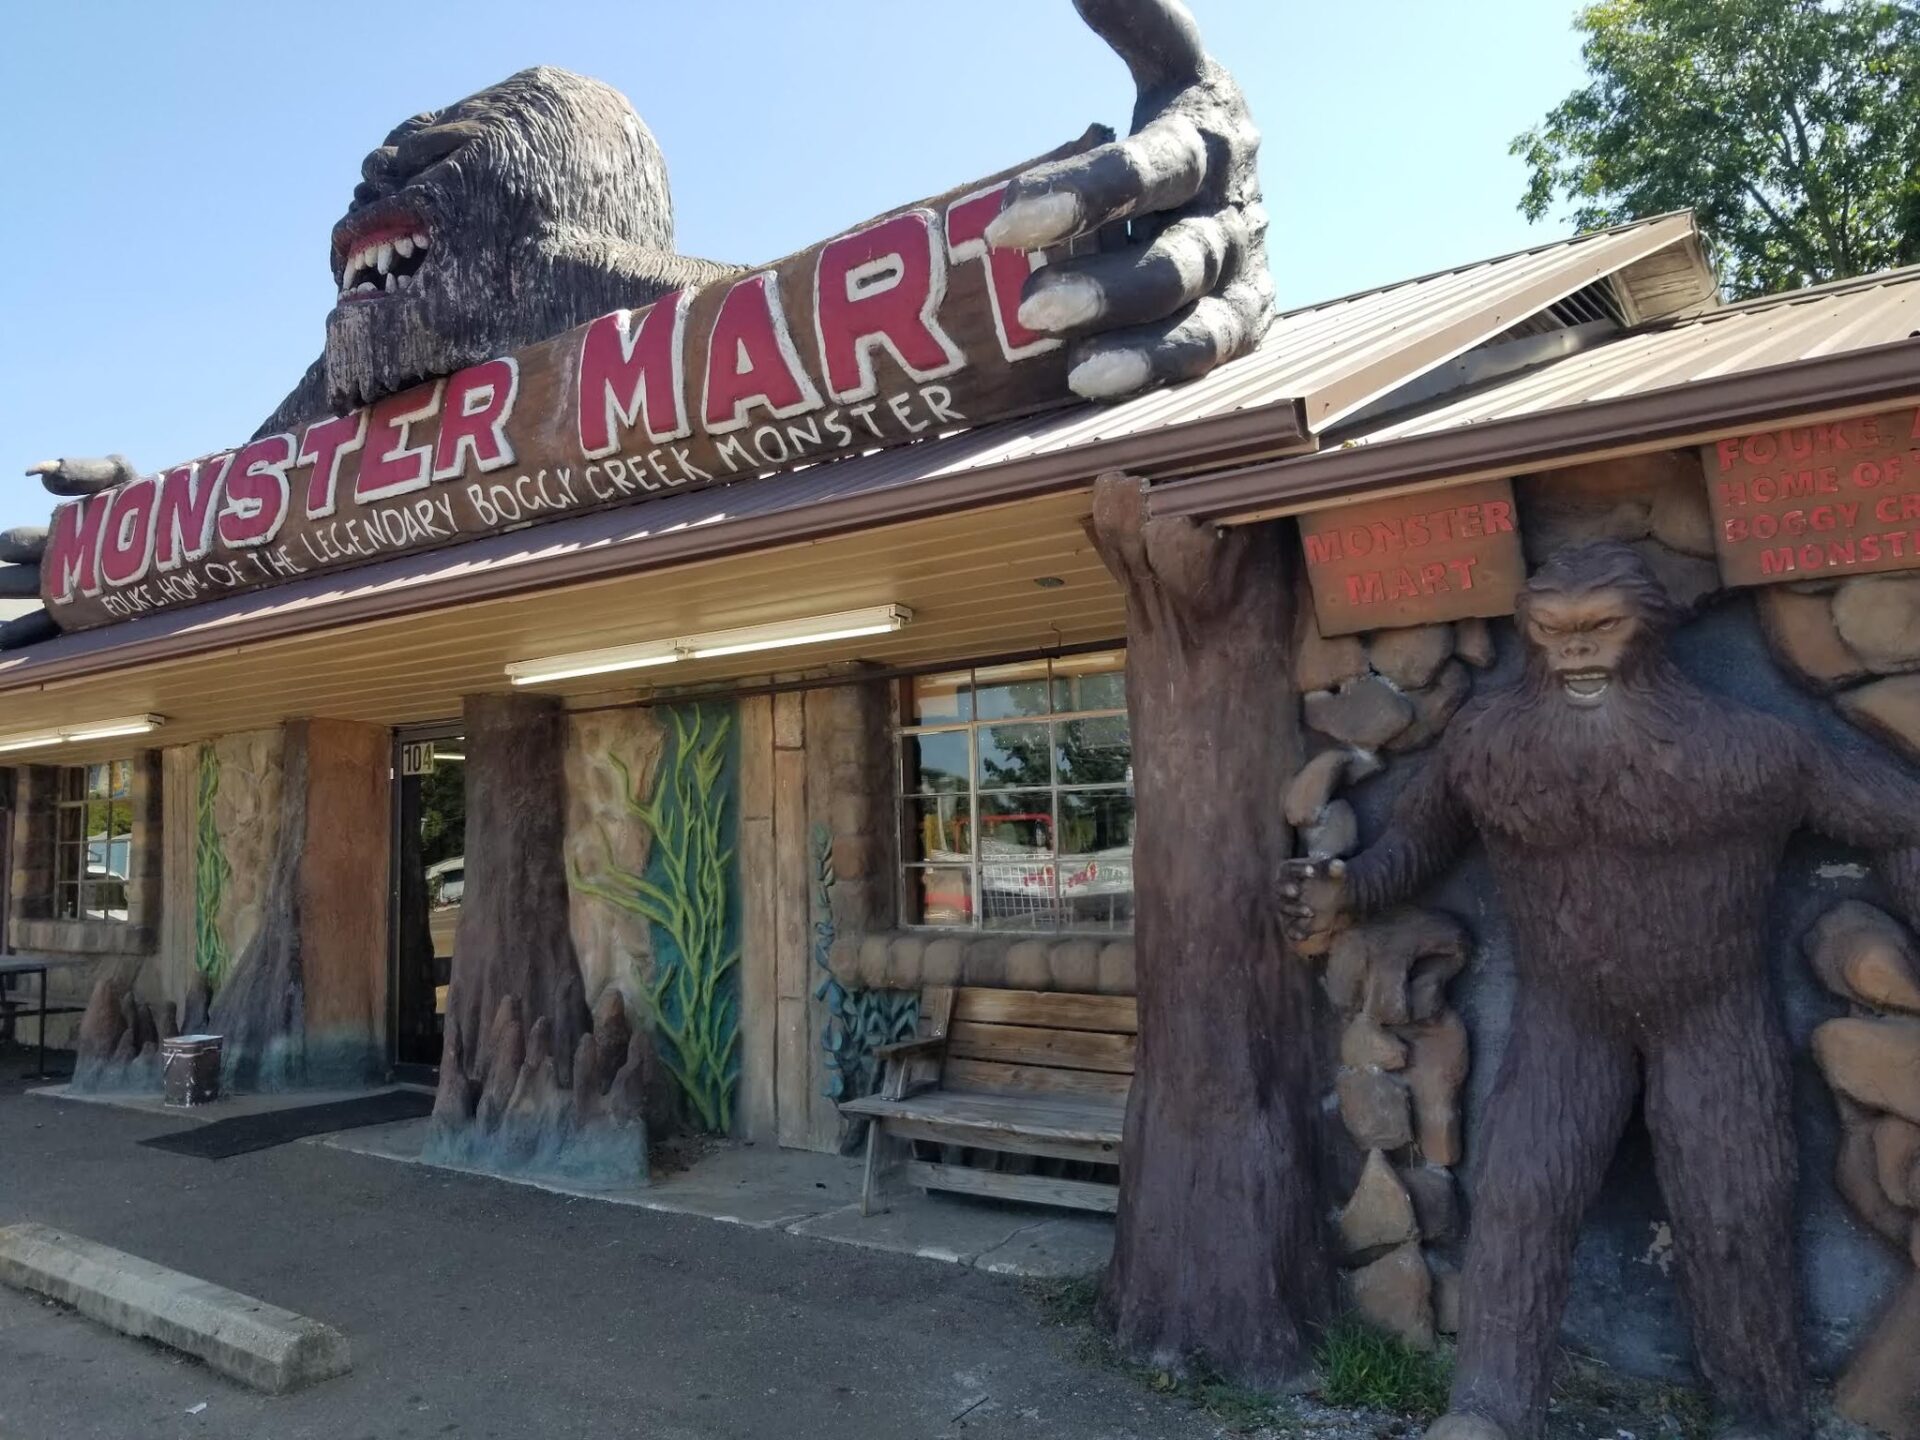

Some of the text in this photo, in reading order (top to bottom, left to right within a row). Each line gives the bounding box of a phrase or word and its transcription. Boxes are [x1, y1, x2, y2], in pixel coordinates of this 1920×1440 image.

[48, 180, 1062, 604] MONSTER MART
[205, 560, 246, 587] OF
[247, 545, 307, 576] THE
[300, 493, 460, 563] LEGENDARY
[467, 467, 579, 526] BOGGY
[585, 446, 713, 500] CREEK
[715, 384, 966, 472] MONSTER
[1718, 467, 1838, 507] HOME
[1852, 458, 1902, 488] OF
[1304, 501, 1514, 564] MONSTER
[1724, 502, 1860, 543] BOGGY
[1761, 531, 1920, 575] MONST
[1345, 554, 1477, 606] MART
[404, 744, 433, 772] 104
